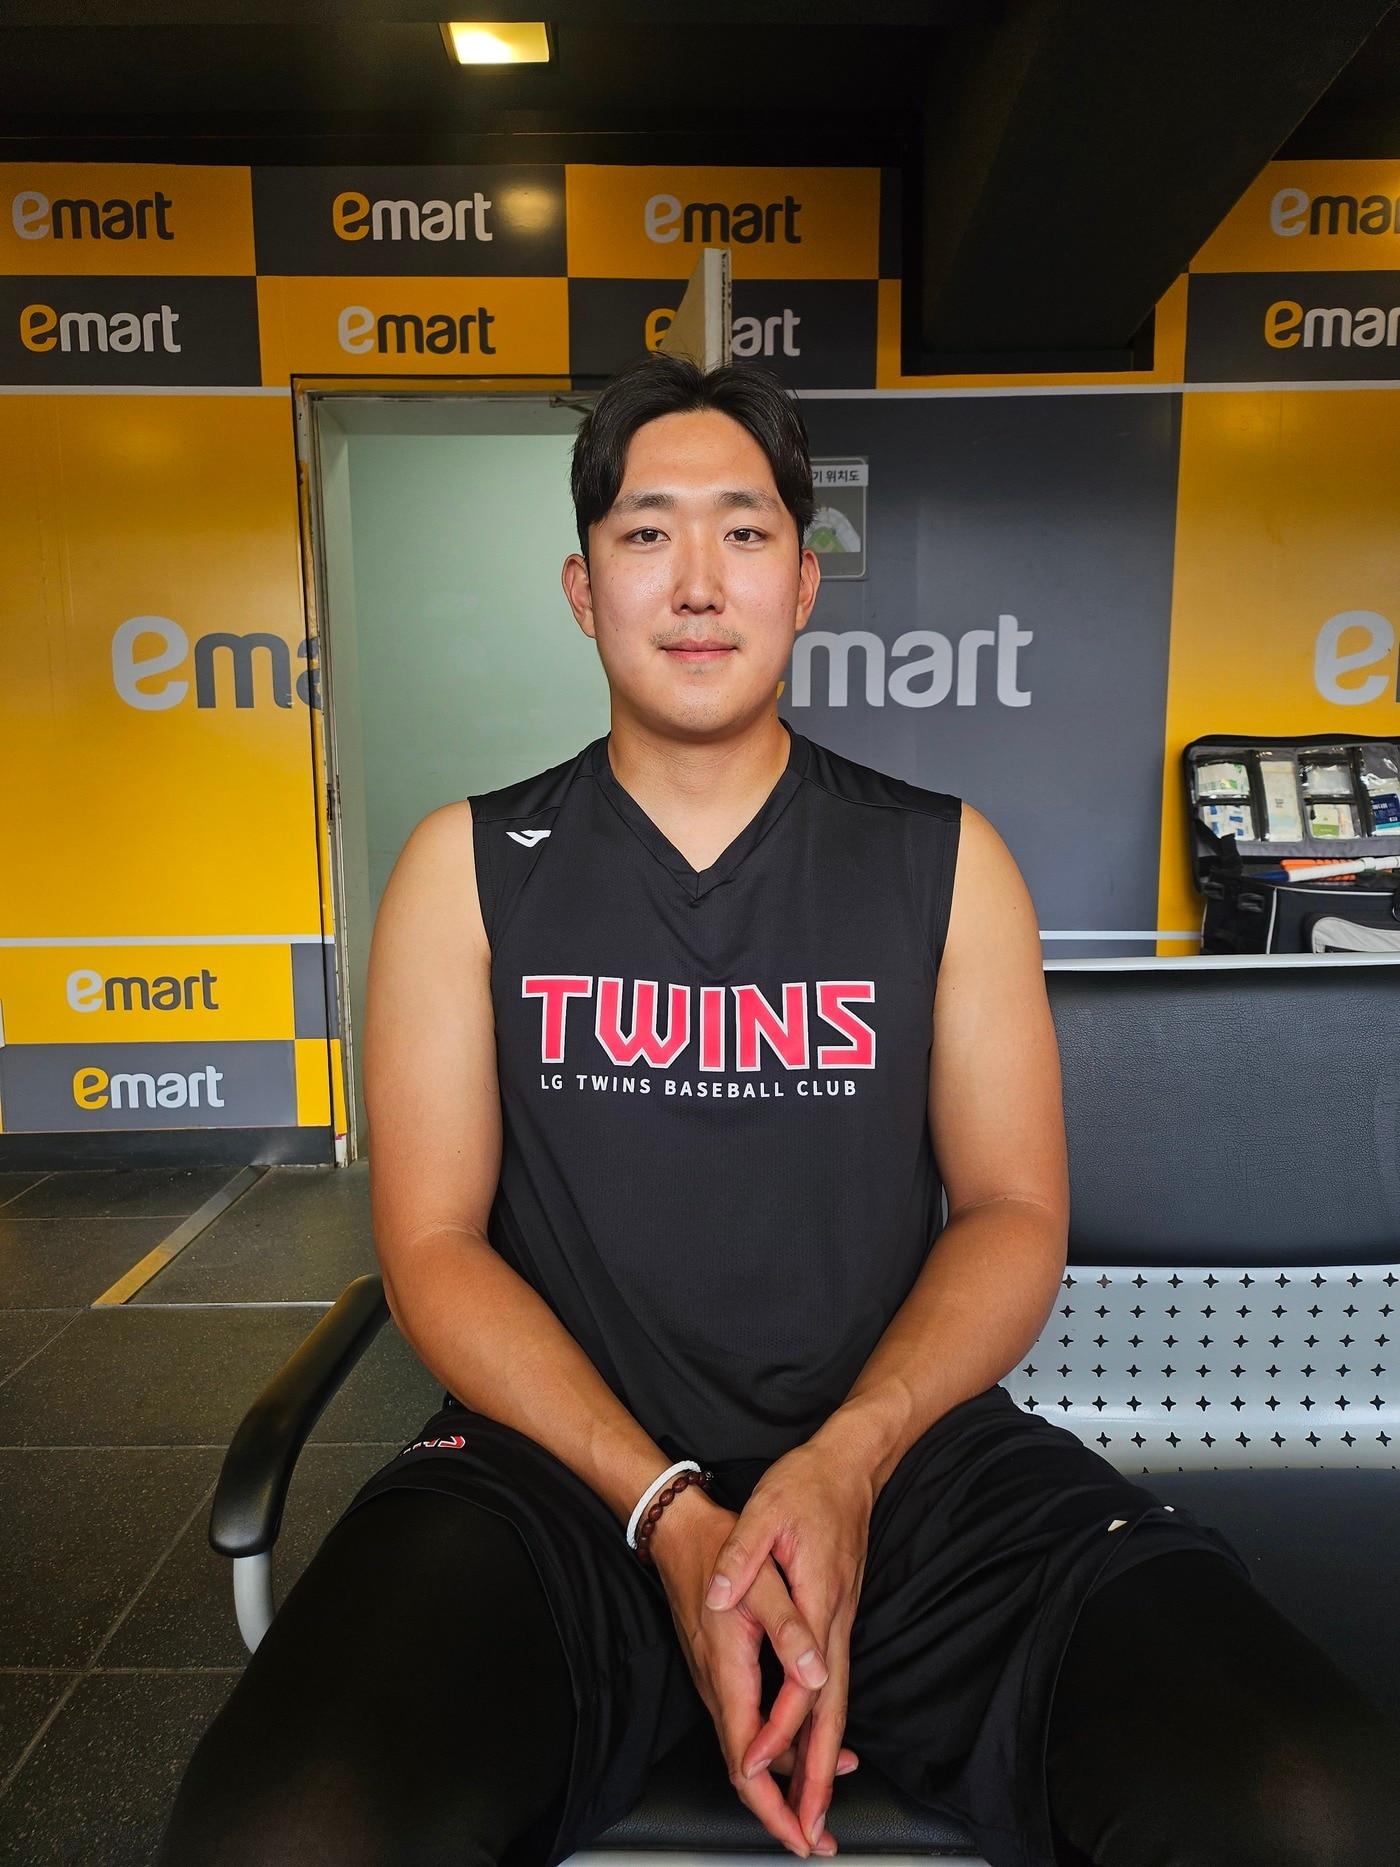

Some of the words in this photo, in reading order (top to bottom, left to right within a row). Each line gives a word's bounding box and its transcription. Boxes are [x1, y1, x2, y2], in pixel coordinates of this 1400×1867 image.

[12, 191, 175, 240] emart
[332, 192, 493, 241] emart
[644, 194, 802, 243] emart
[1270, 188, 1400, 236] ema
[20, 305, 181, 353] emart
[338, 306, 496, 355] emart
[776, 614, 1034, 708] mart
[66, 969, 219, 1012] emart
[521, 976, 877, 1072] TWINS
[73, 1066, 225, 1109] emart
[541, 1074, 564, 1090] LG
[576, 1075, 652, 1094] TWINS
[665, 1080, 785, 1098] BASEBALL
[797, 1080, 857, 1096] CLUB
